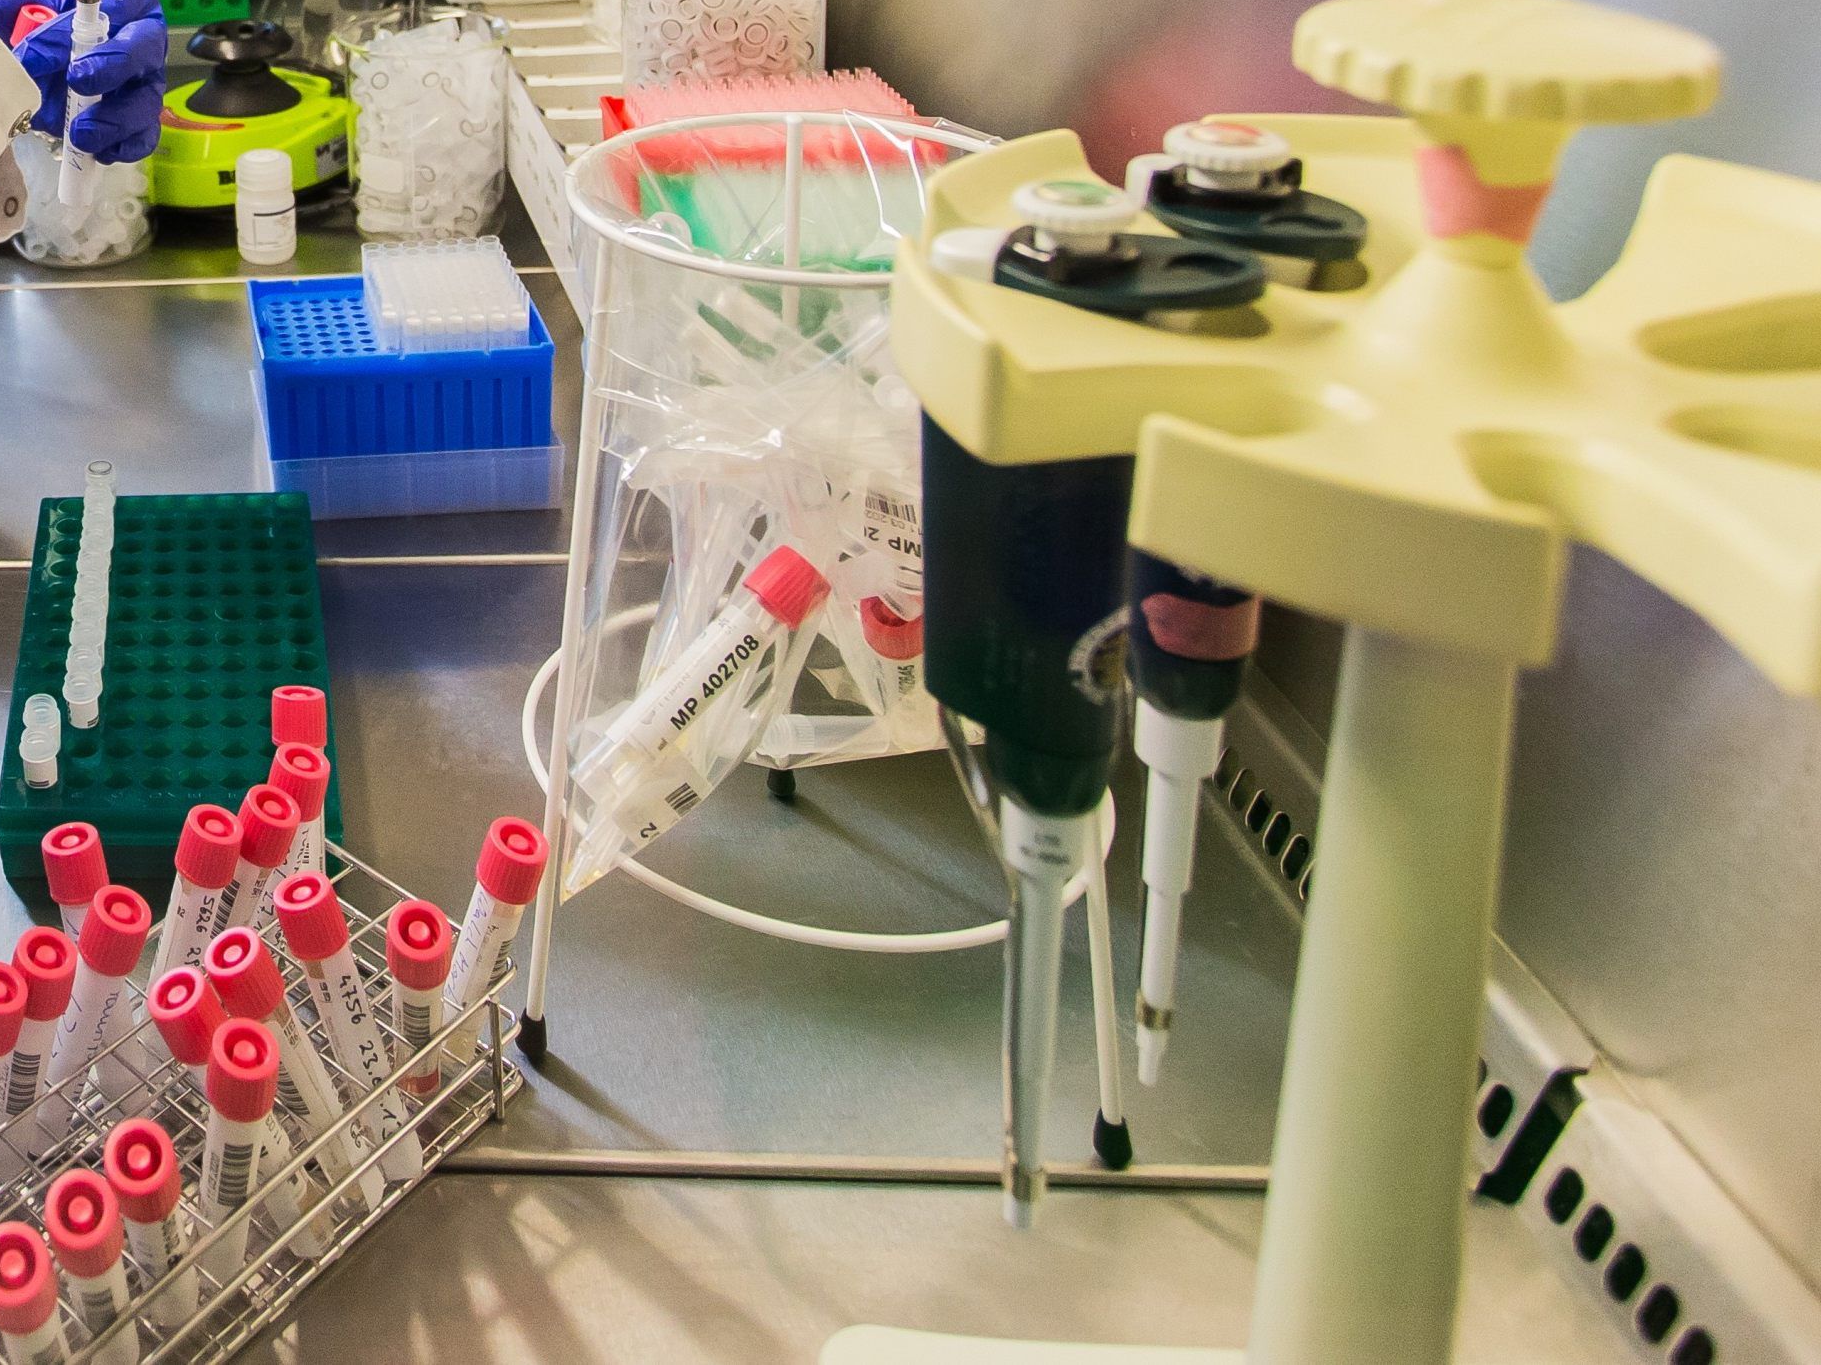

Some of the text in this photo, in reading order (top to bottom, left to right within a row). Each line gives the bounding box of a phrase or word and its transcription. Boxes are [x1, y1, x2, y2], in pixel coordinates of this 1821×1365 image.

[670, 697, 699, 731] MP
[701, 634, 760, 699] 402708
[338, 975, 362, 1025] 4756
